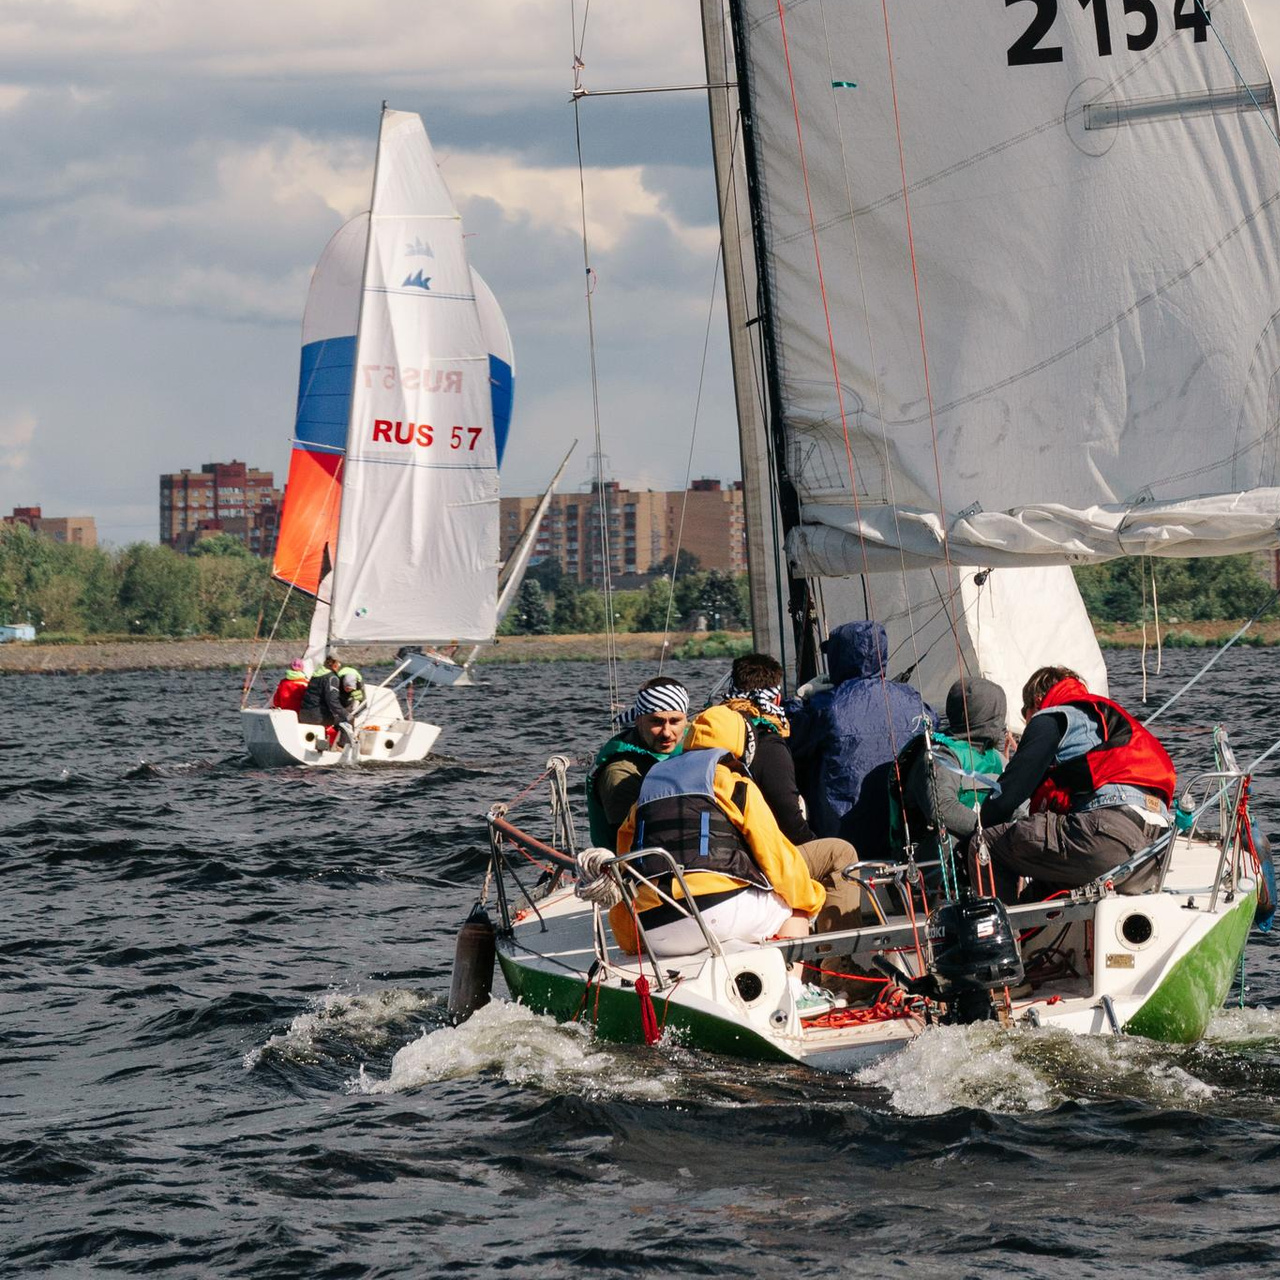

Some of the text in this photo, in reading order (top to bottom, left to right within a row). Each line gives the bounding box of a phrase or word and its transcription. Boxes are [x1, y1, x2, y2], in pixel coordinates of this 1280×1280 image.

[372, 419, 483, 451] RUS 57
[977, 920, 995, 938] 5
